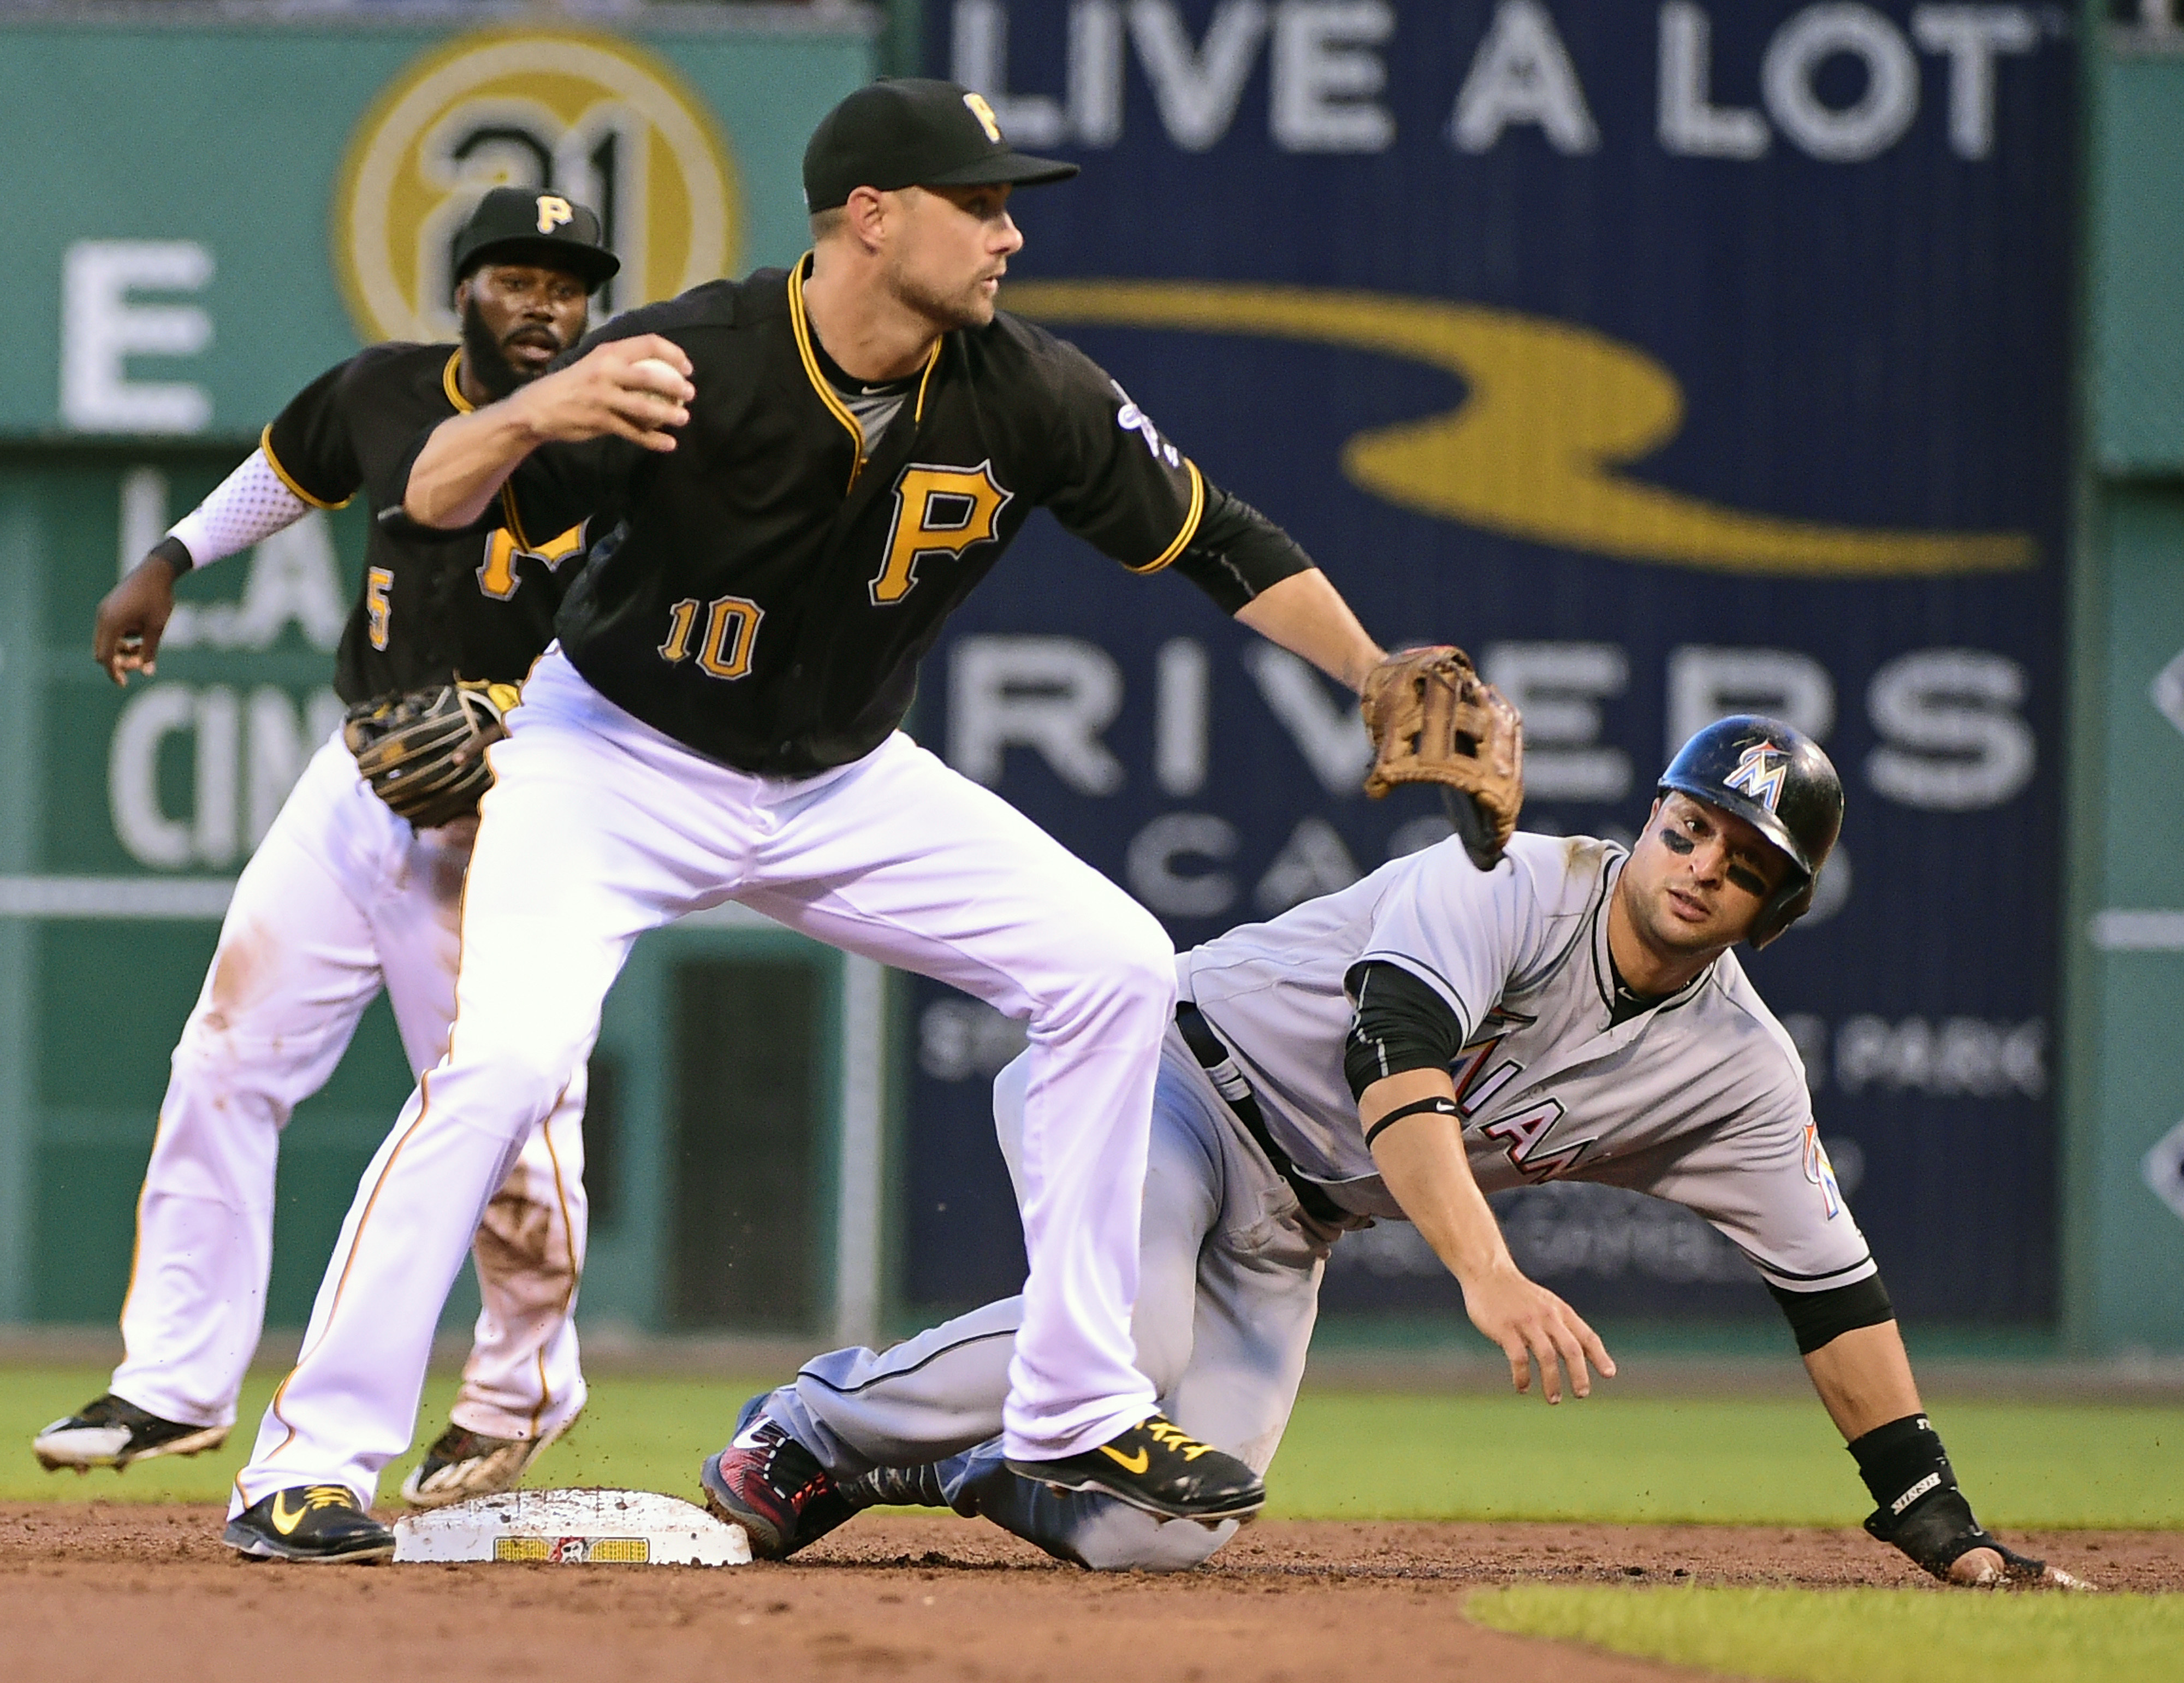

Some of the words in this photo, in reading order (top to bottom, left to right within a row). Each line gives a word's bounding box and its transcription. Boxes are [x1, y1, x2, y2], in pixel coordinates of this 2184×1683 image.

[953, 0, 1396, 153] LIVE
[1447, 0, 1601, 155] A
[1657, 0, 2038, 162] LOT
[536, 194, 573, 235] P
[61, 239, 213, 432] E
[868, 460, 1013, 606] P
[367, 566, 394, 651] 5
[658, 595, 764, 680] 10
